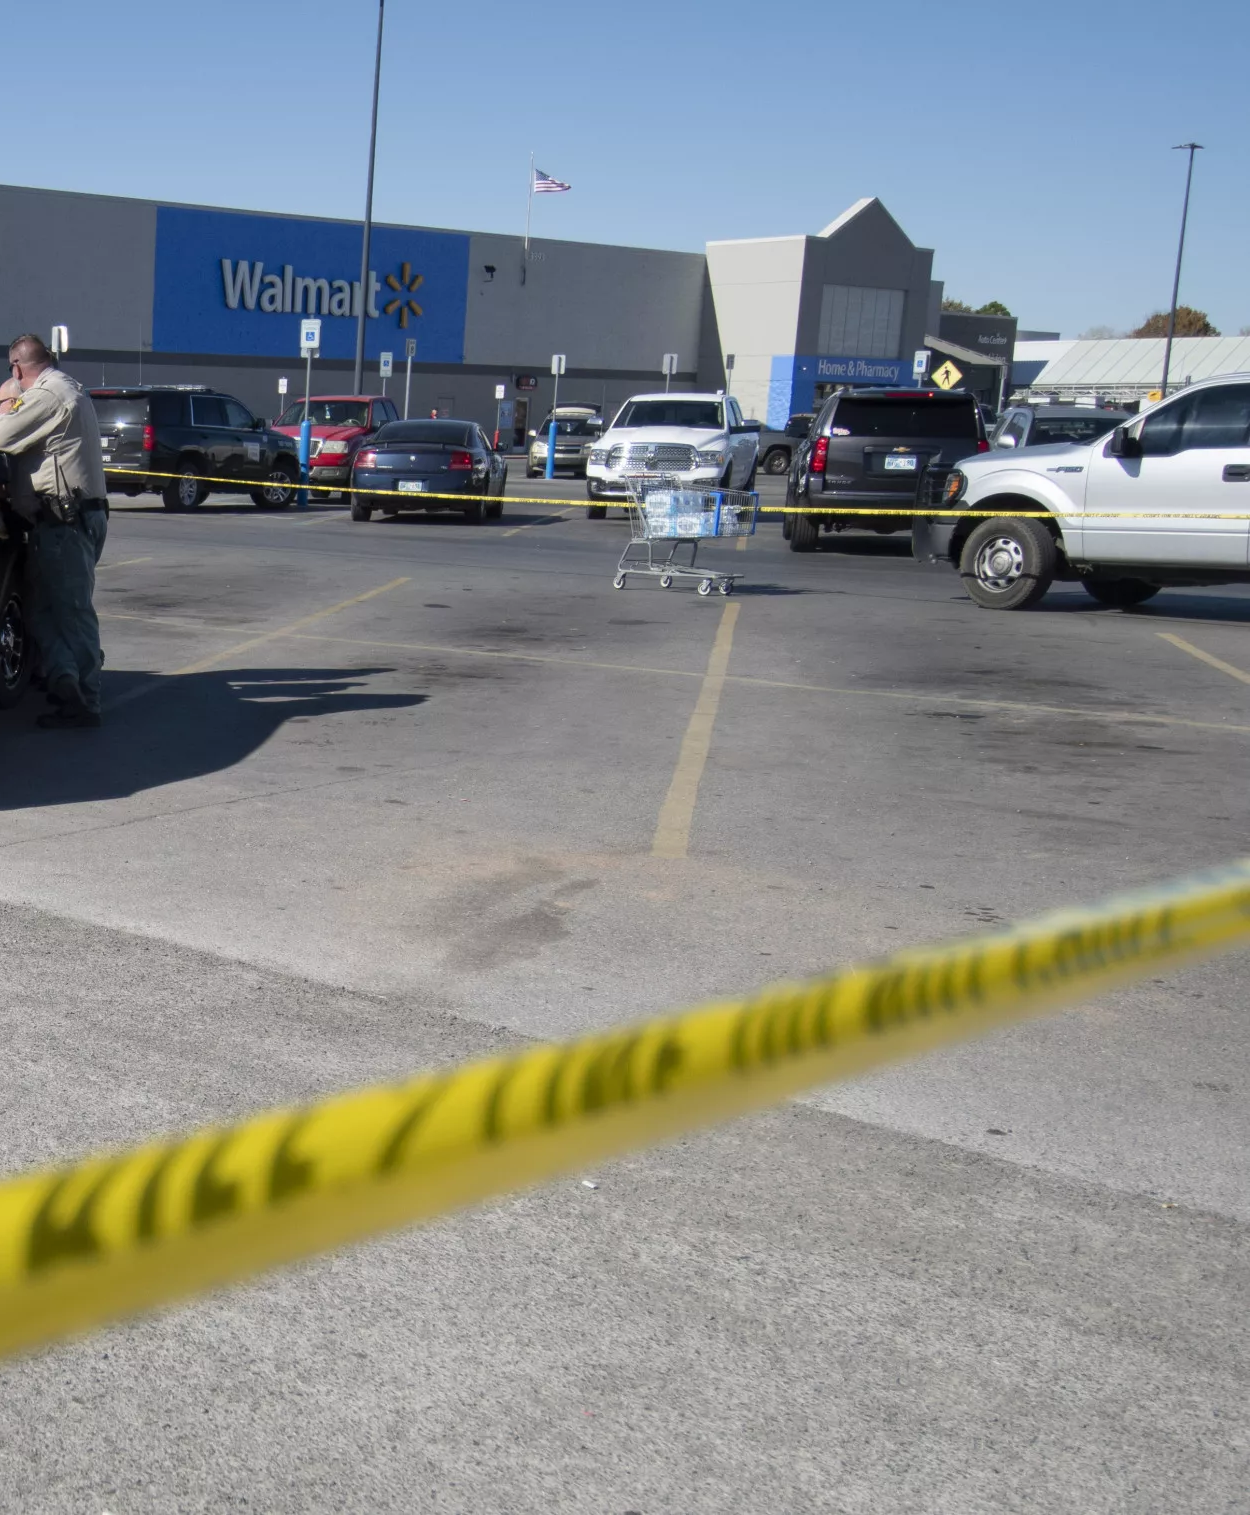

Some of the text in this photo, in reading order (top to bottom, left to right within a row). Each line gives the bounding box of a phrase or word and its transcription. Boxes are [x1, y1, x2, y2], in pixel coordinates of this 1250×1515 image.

[221, 258, 381, 318] Walmart
[818, 360, 899, 381] Home & Pharmacy
